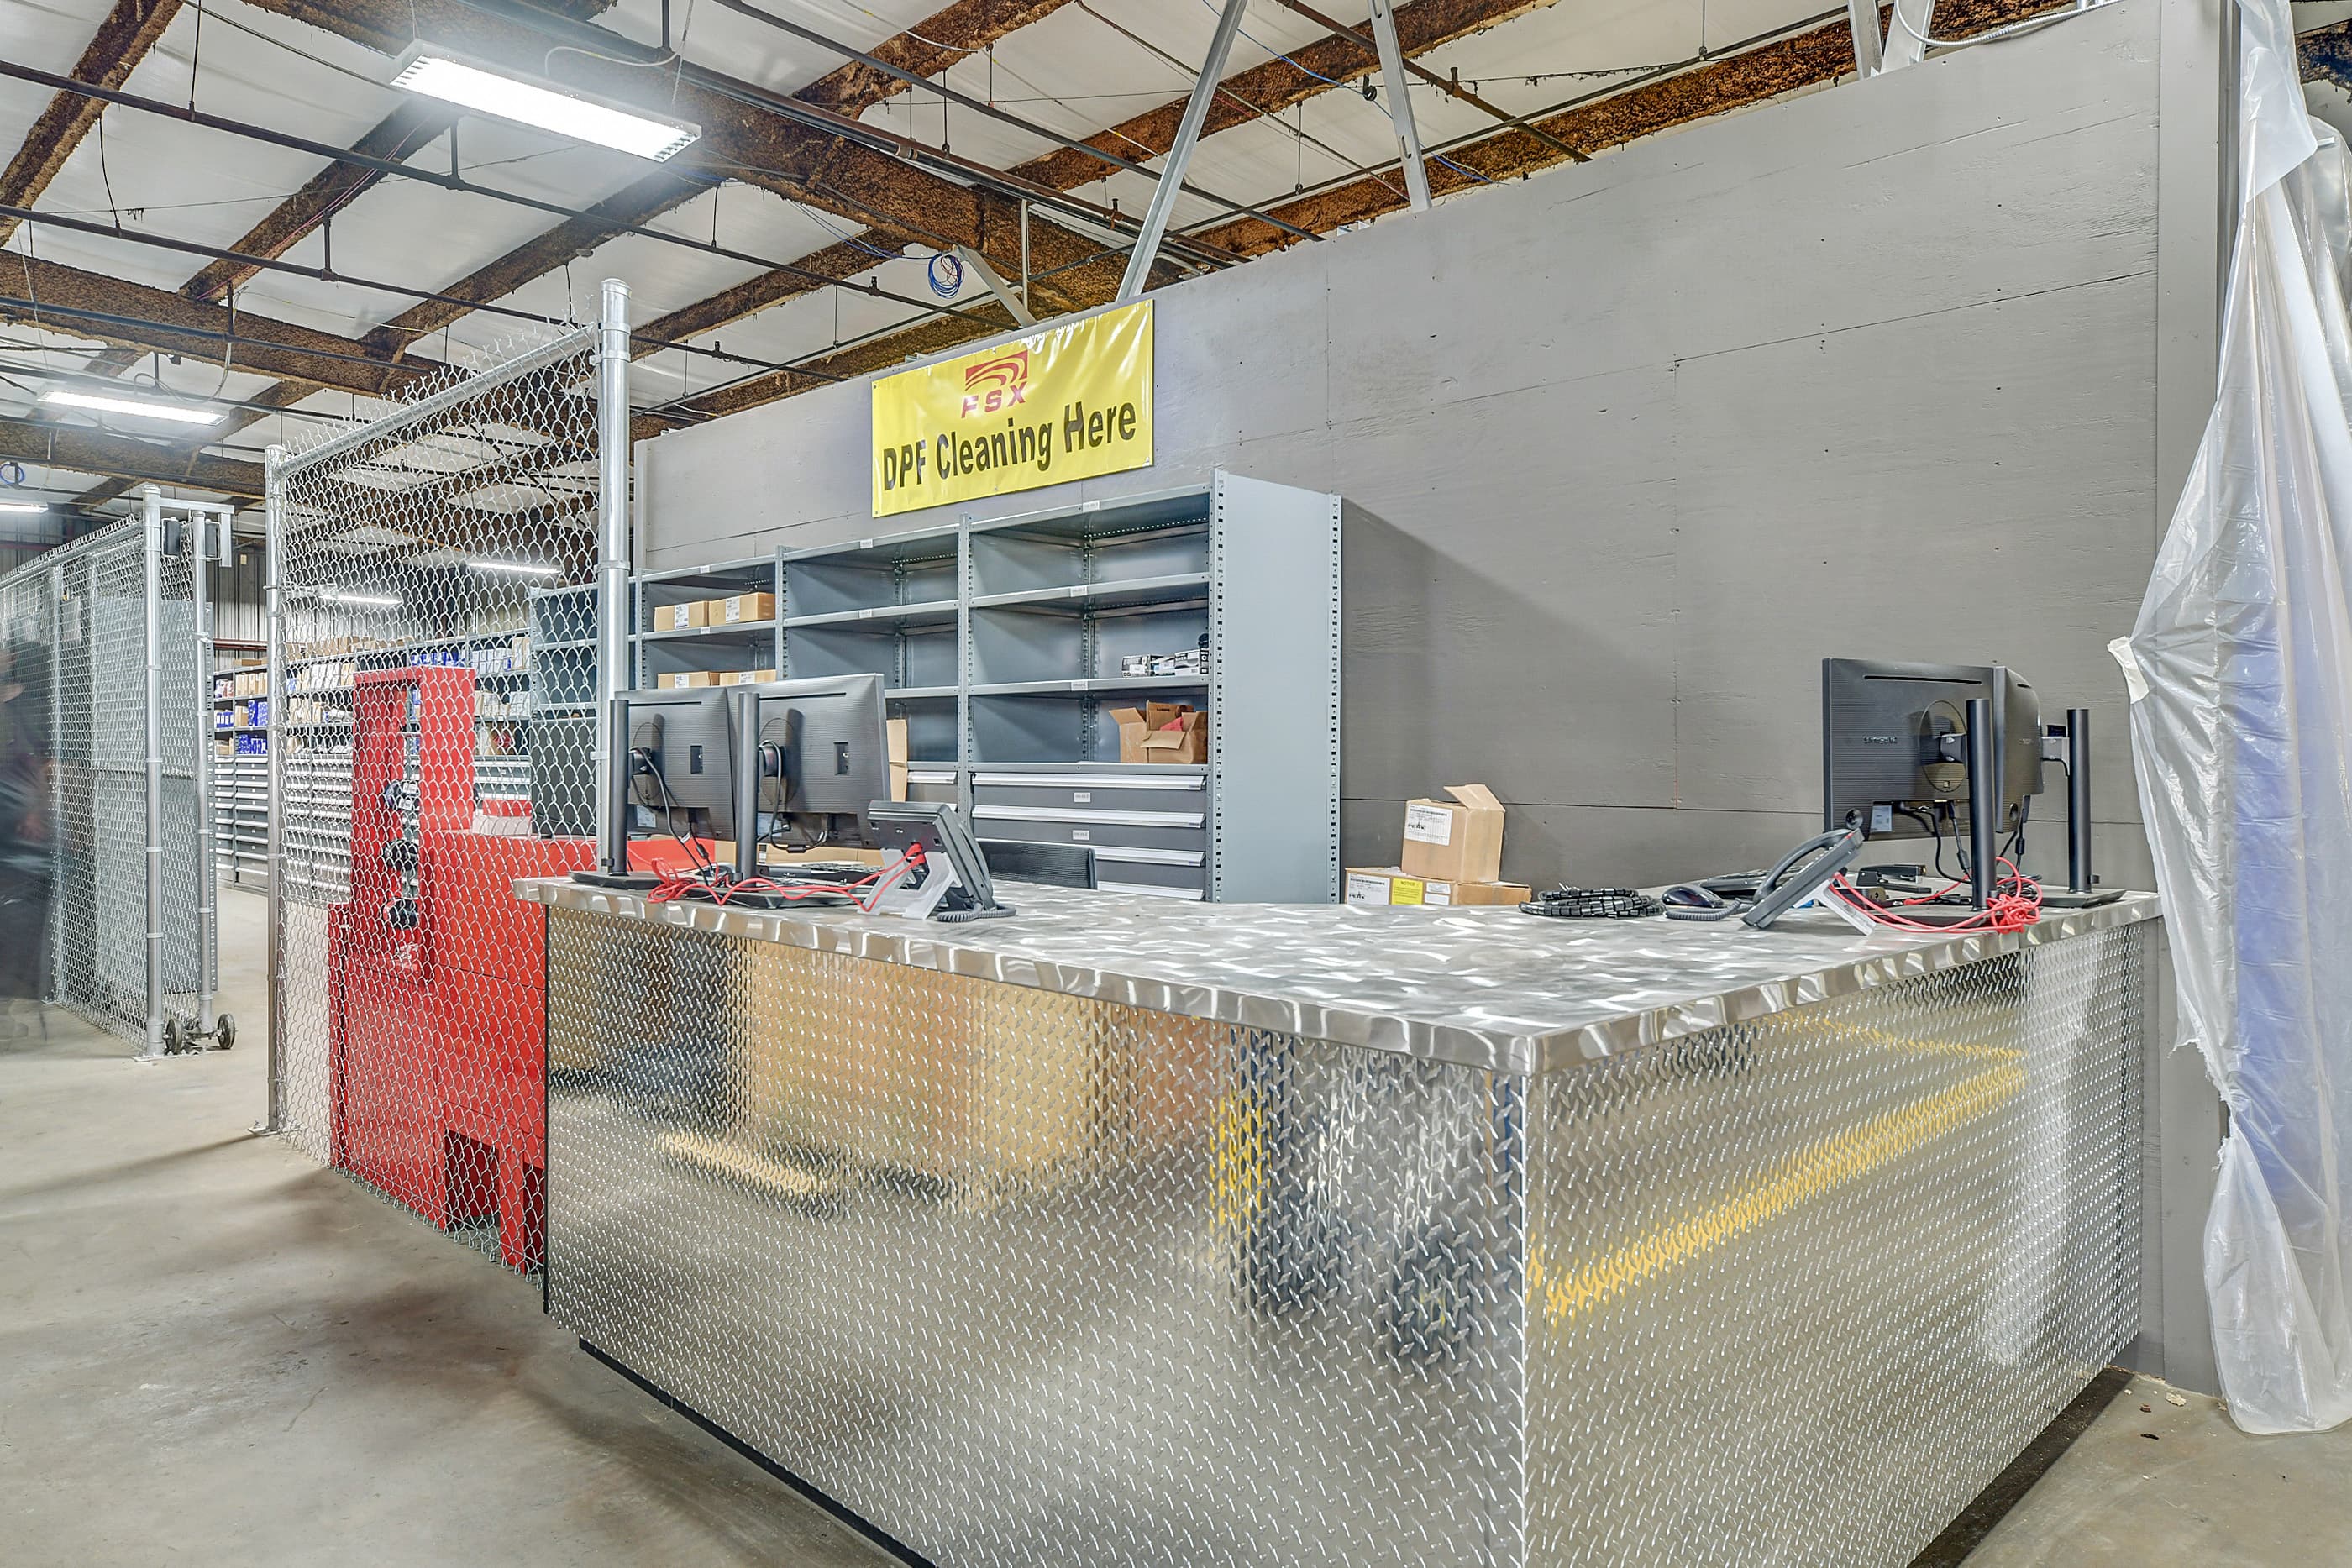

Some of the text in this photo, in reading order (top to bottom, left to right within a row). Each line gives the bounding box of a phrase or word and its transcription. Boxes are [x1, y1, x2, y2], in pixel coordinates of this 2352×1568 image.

[961, 381, 1027, 418] FSX
[883, 401, 1137, 491] DPF Cleaning Here
